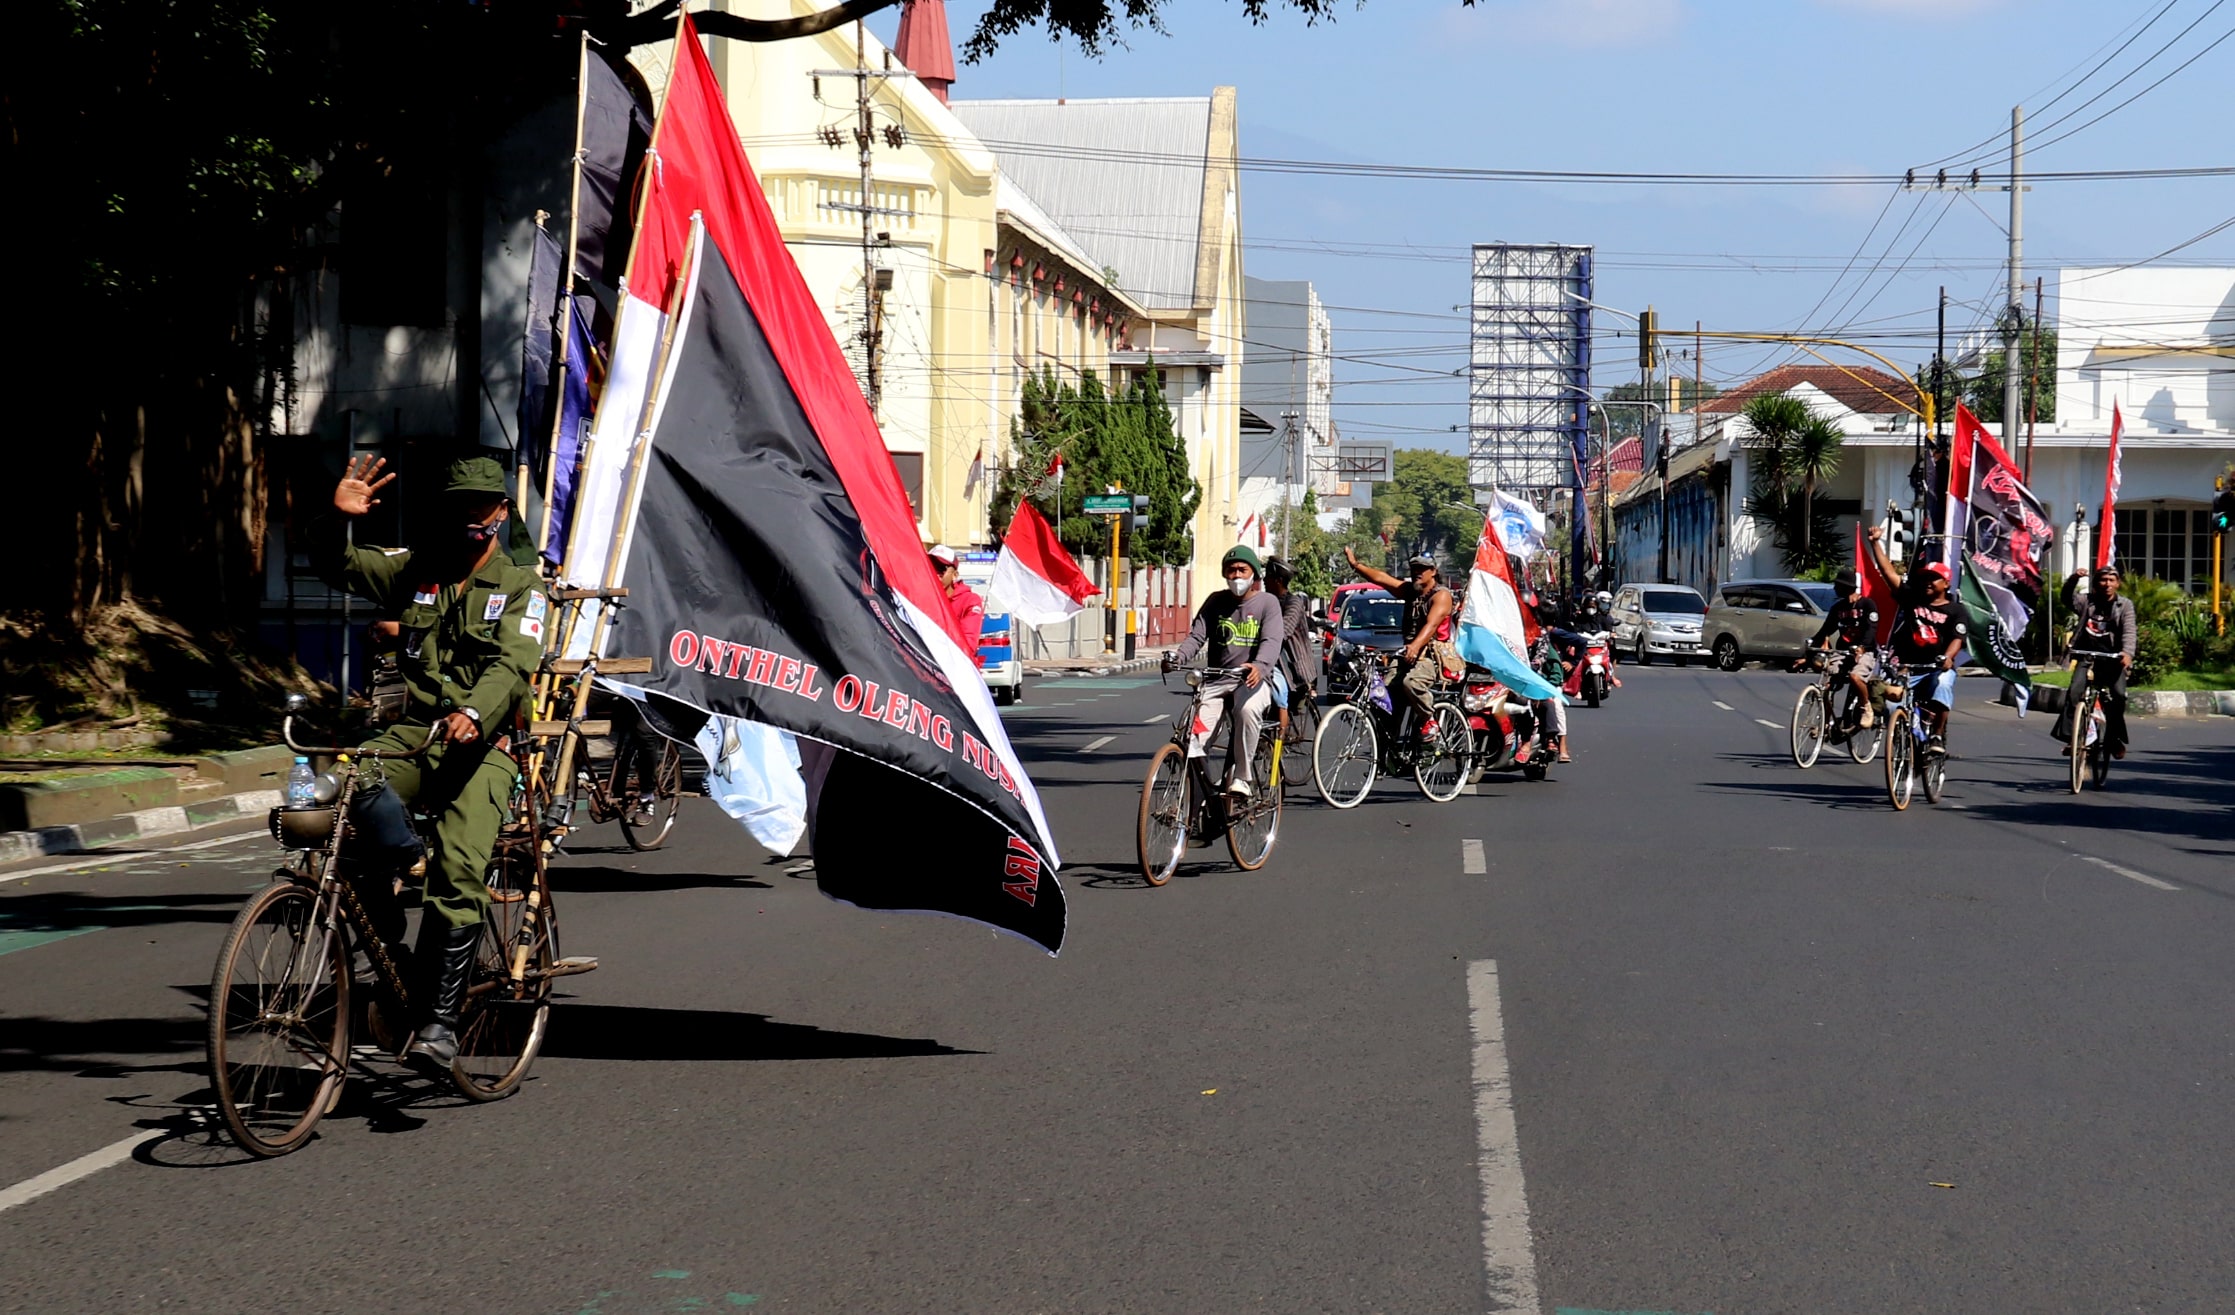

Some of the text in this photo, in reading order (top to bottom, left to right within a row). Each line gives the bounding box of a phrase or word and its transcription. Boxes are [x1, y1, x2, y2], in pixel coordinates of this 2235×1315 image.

[669, 629, 823, 701] ONTHEL
[833, 674, 954, 753] OLENG
[962, 730, 1027, 808] NUS
